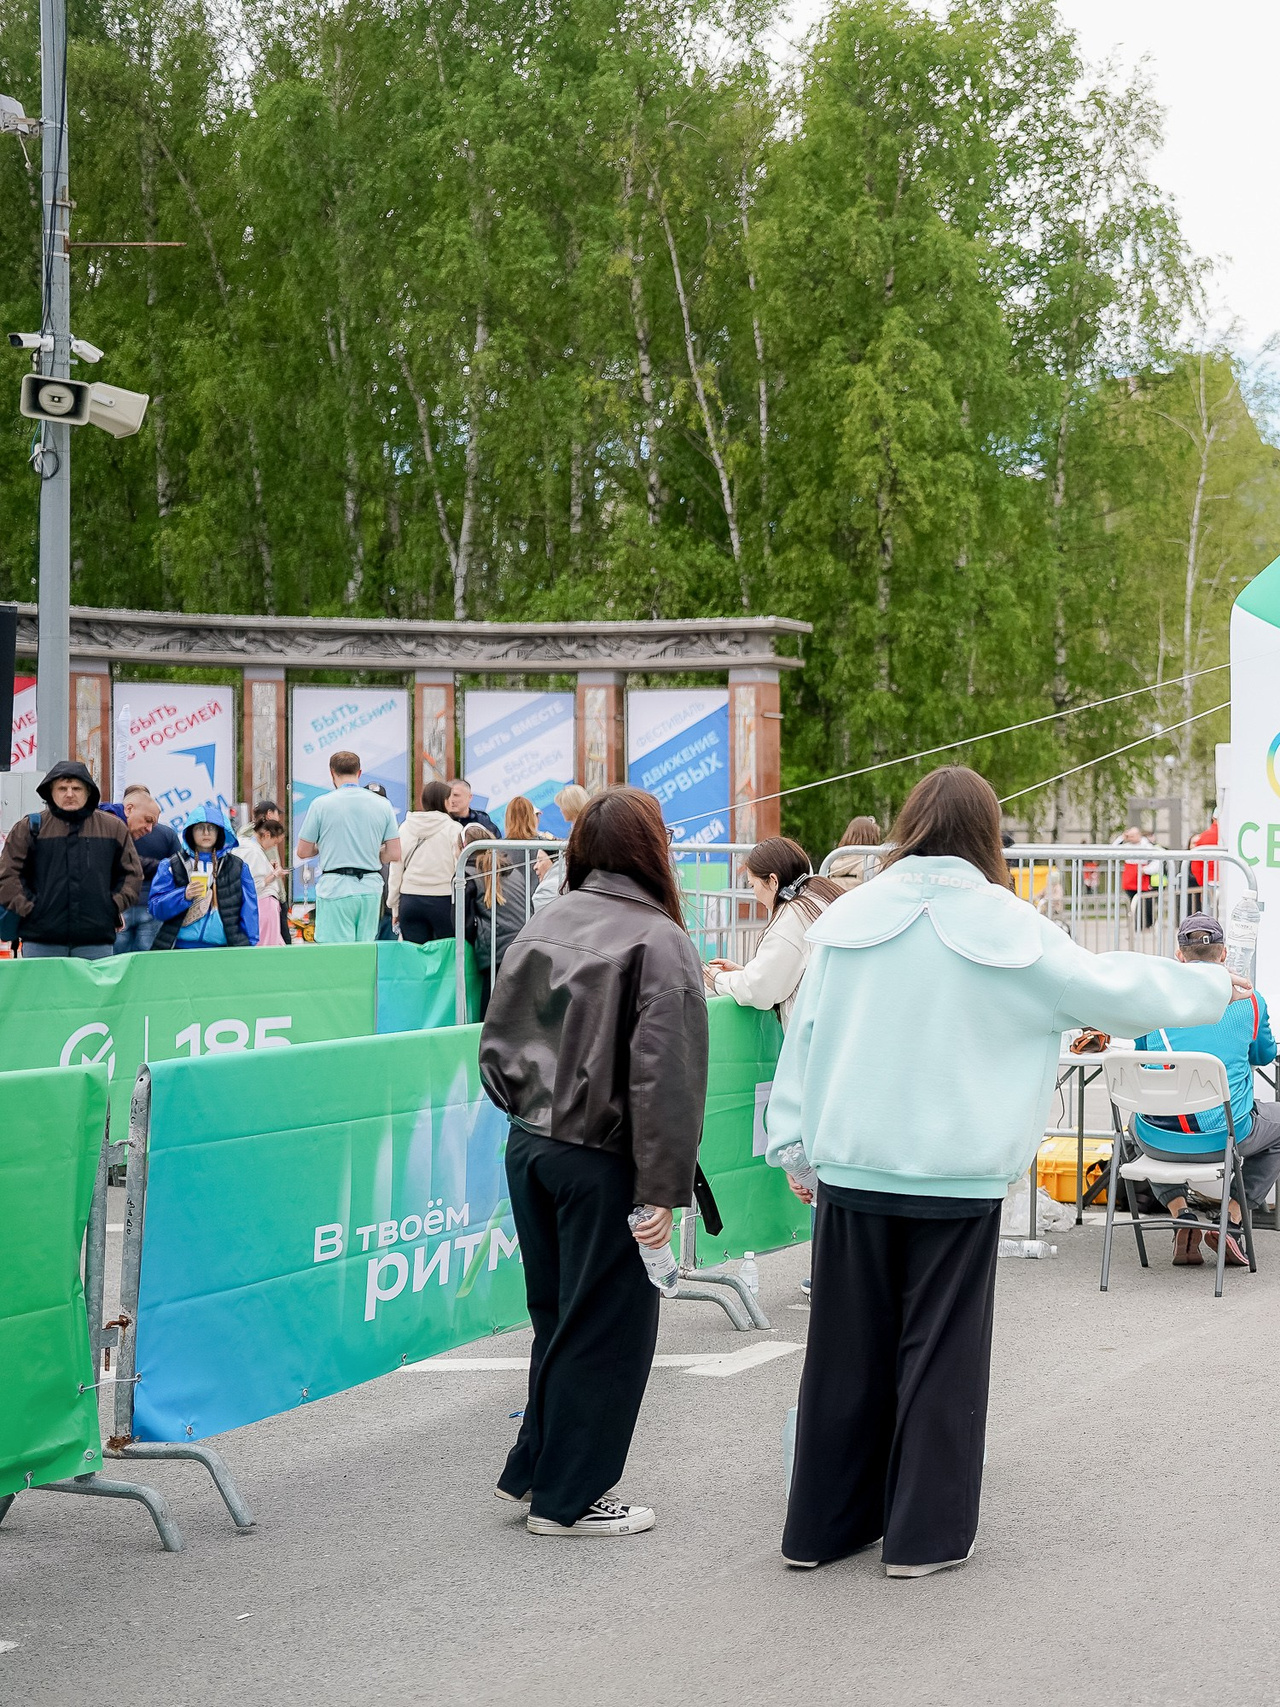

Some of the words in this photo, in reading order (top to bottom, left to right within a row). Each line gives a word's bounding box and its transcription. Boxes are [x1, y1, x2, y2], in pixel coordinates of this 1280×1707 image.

[139, 698, 224, 753] РОССИЕЙ
[310, 703, 359, 733] БЫТЬ
[641, 730, 720, 789] ДВИЖЕНИЕ
[651, 750, 724, 806] ЕРВЫХ
[314, 1223, 345, 1263] В
[355, 1198, 470, 1252] твоём
[364, 1227, 524, 1321] ритм
